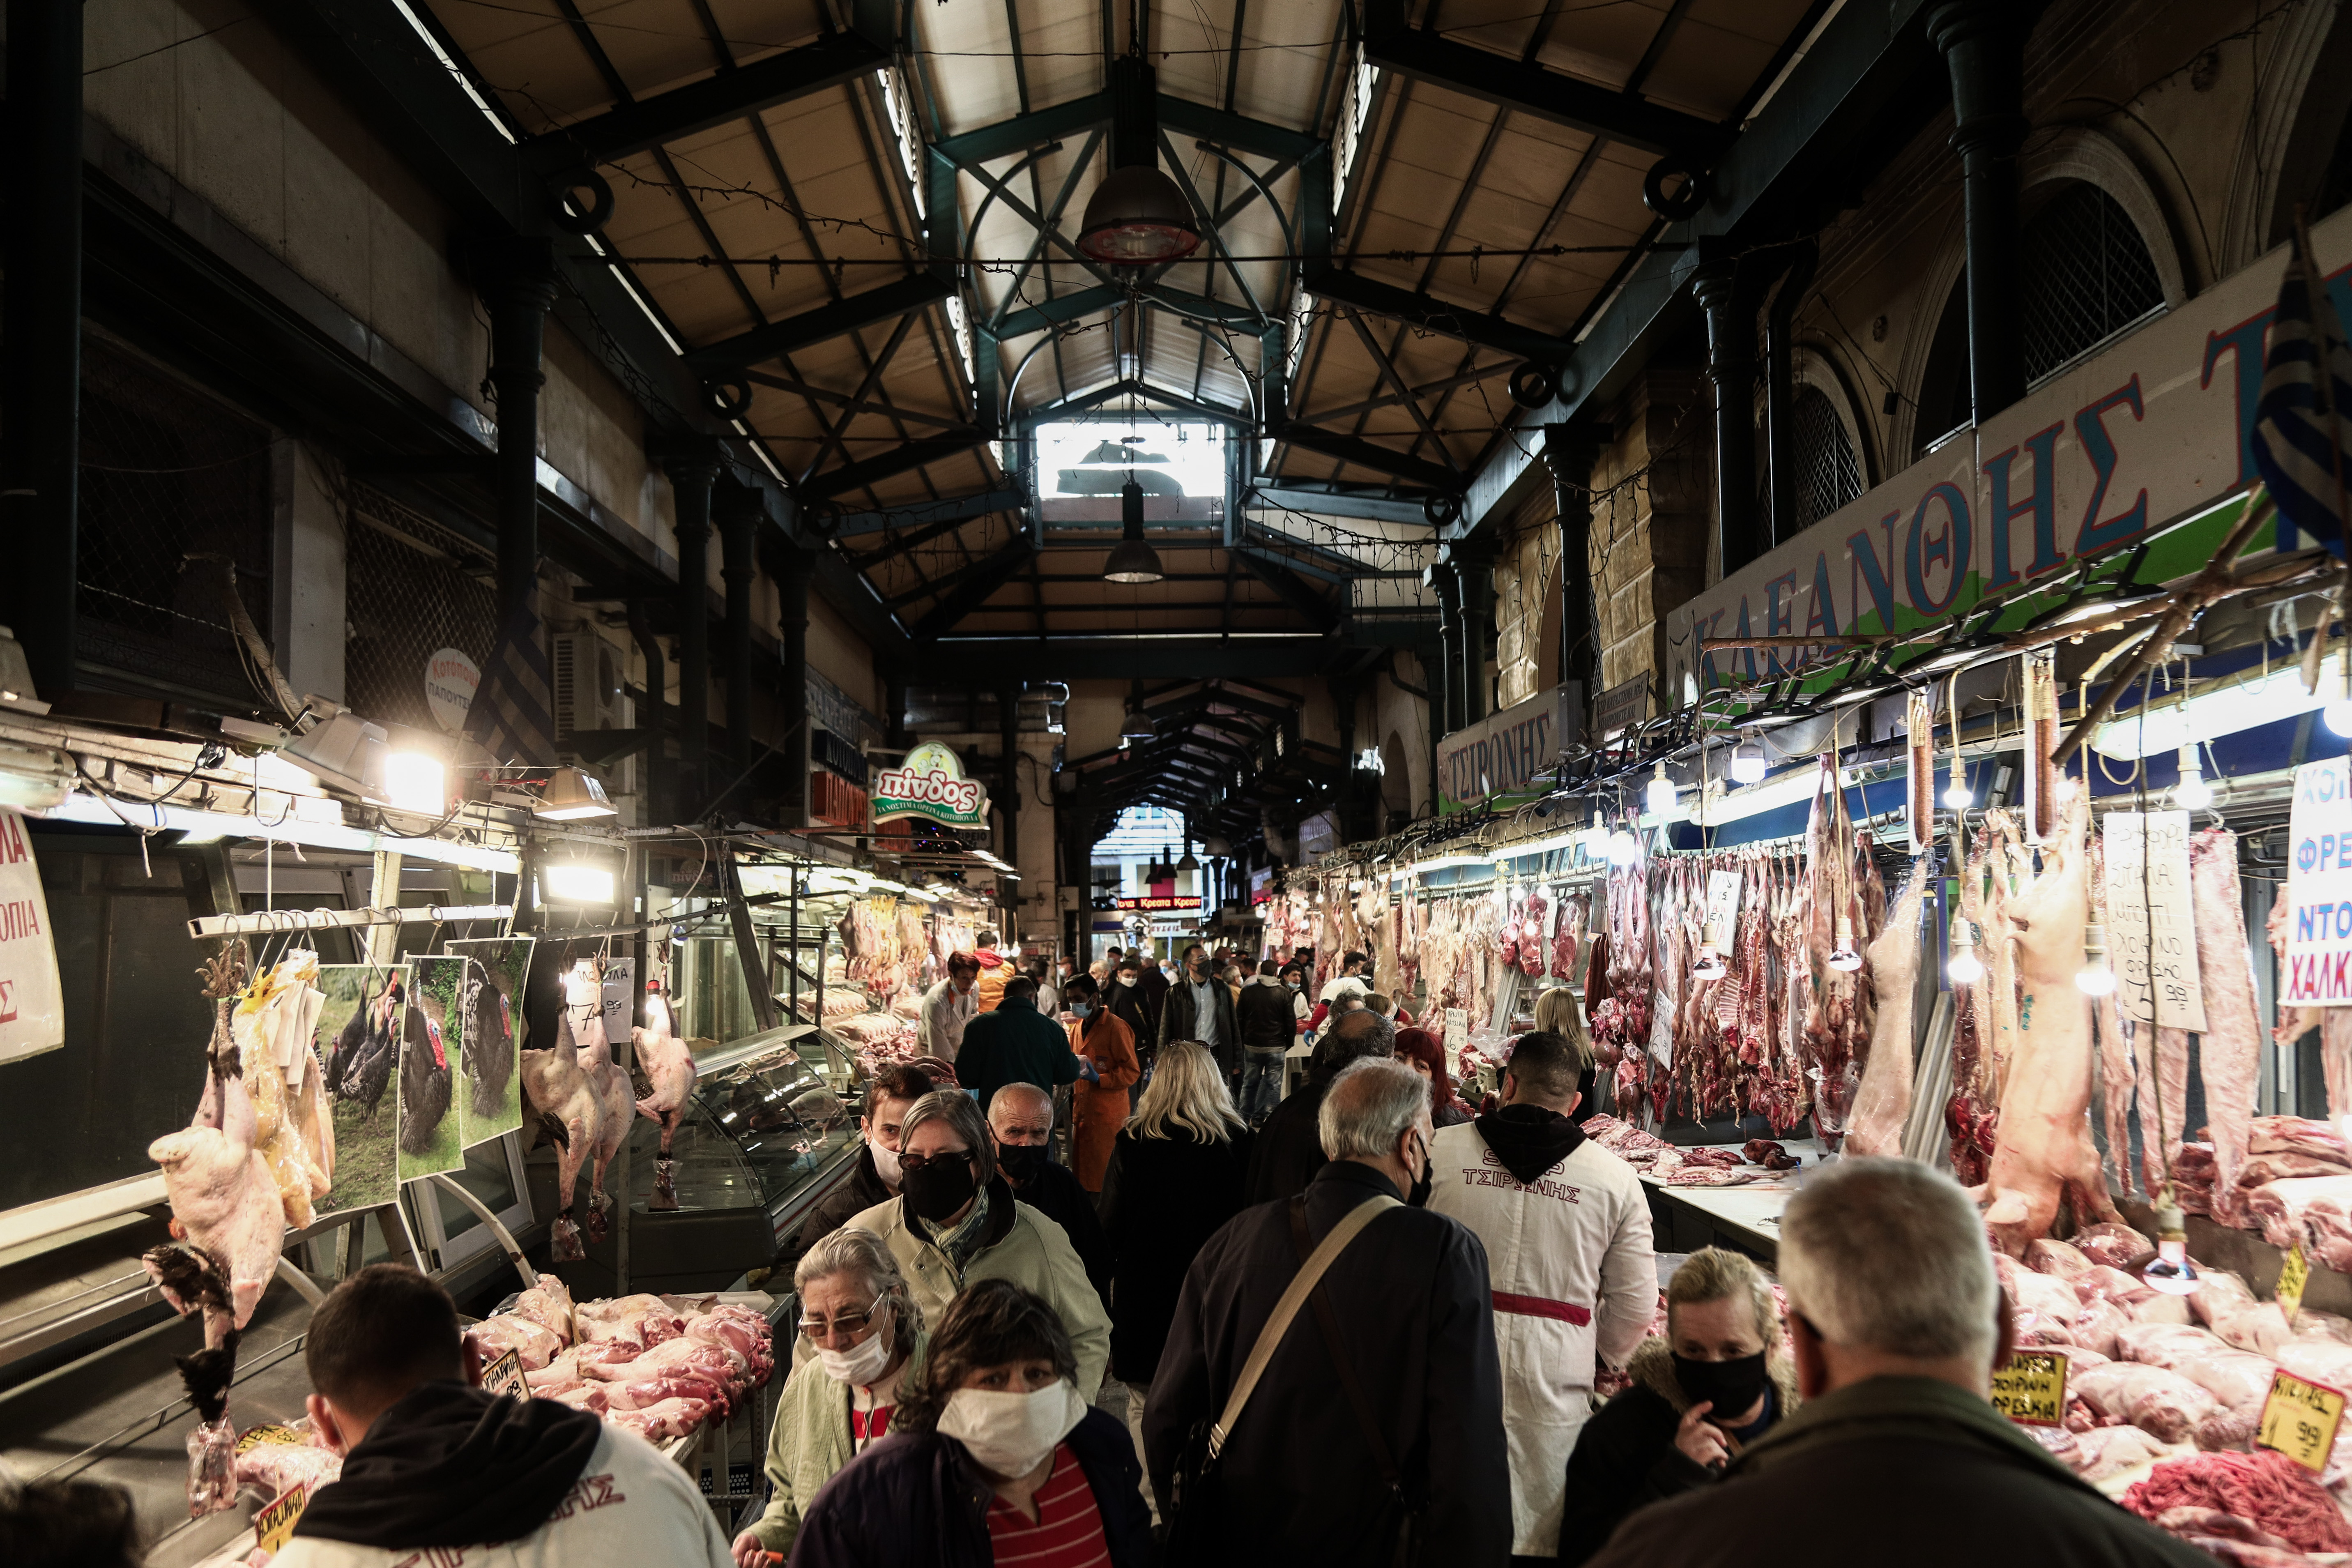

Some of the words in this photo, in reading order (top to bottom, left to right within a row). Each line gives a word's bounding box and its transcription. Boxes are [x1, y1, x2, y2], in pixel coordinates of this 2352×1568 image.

[1693, 372, 2149, 694] ΚΛΕΑΝΘΗΣ
[1450, 708, 1551, 802] ΤΣΙΡΩΝΗΣ
[886, 801, 916, 813] ΝΟΣΤΙΜΑ
[917, 803, 940, 817] ΟΡΕΙΝΑ
[940, 811, 978, 821] ΚΟΤΟΠΟΥΛΑ
[1482, 1149, 1565, 1176] SP
[1463, 1169, 1581, 1204] ΤΣΙΡΩΝΗΣ
[483, 1352, 519, 1392] ΟΠΑΝΑΚΙΑ
